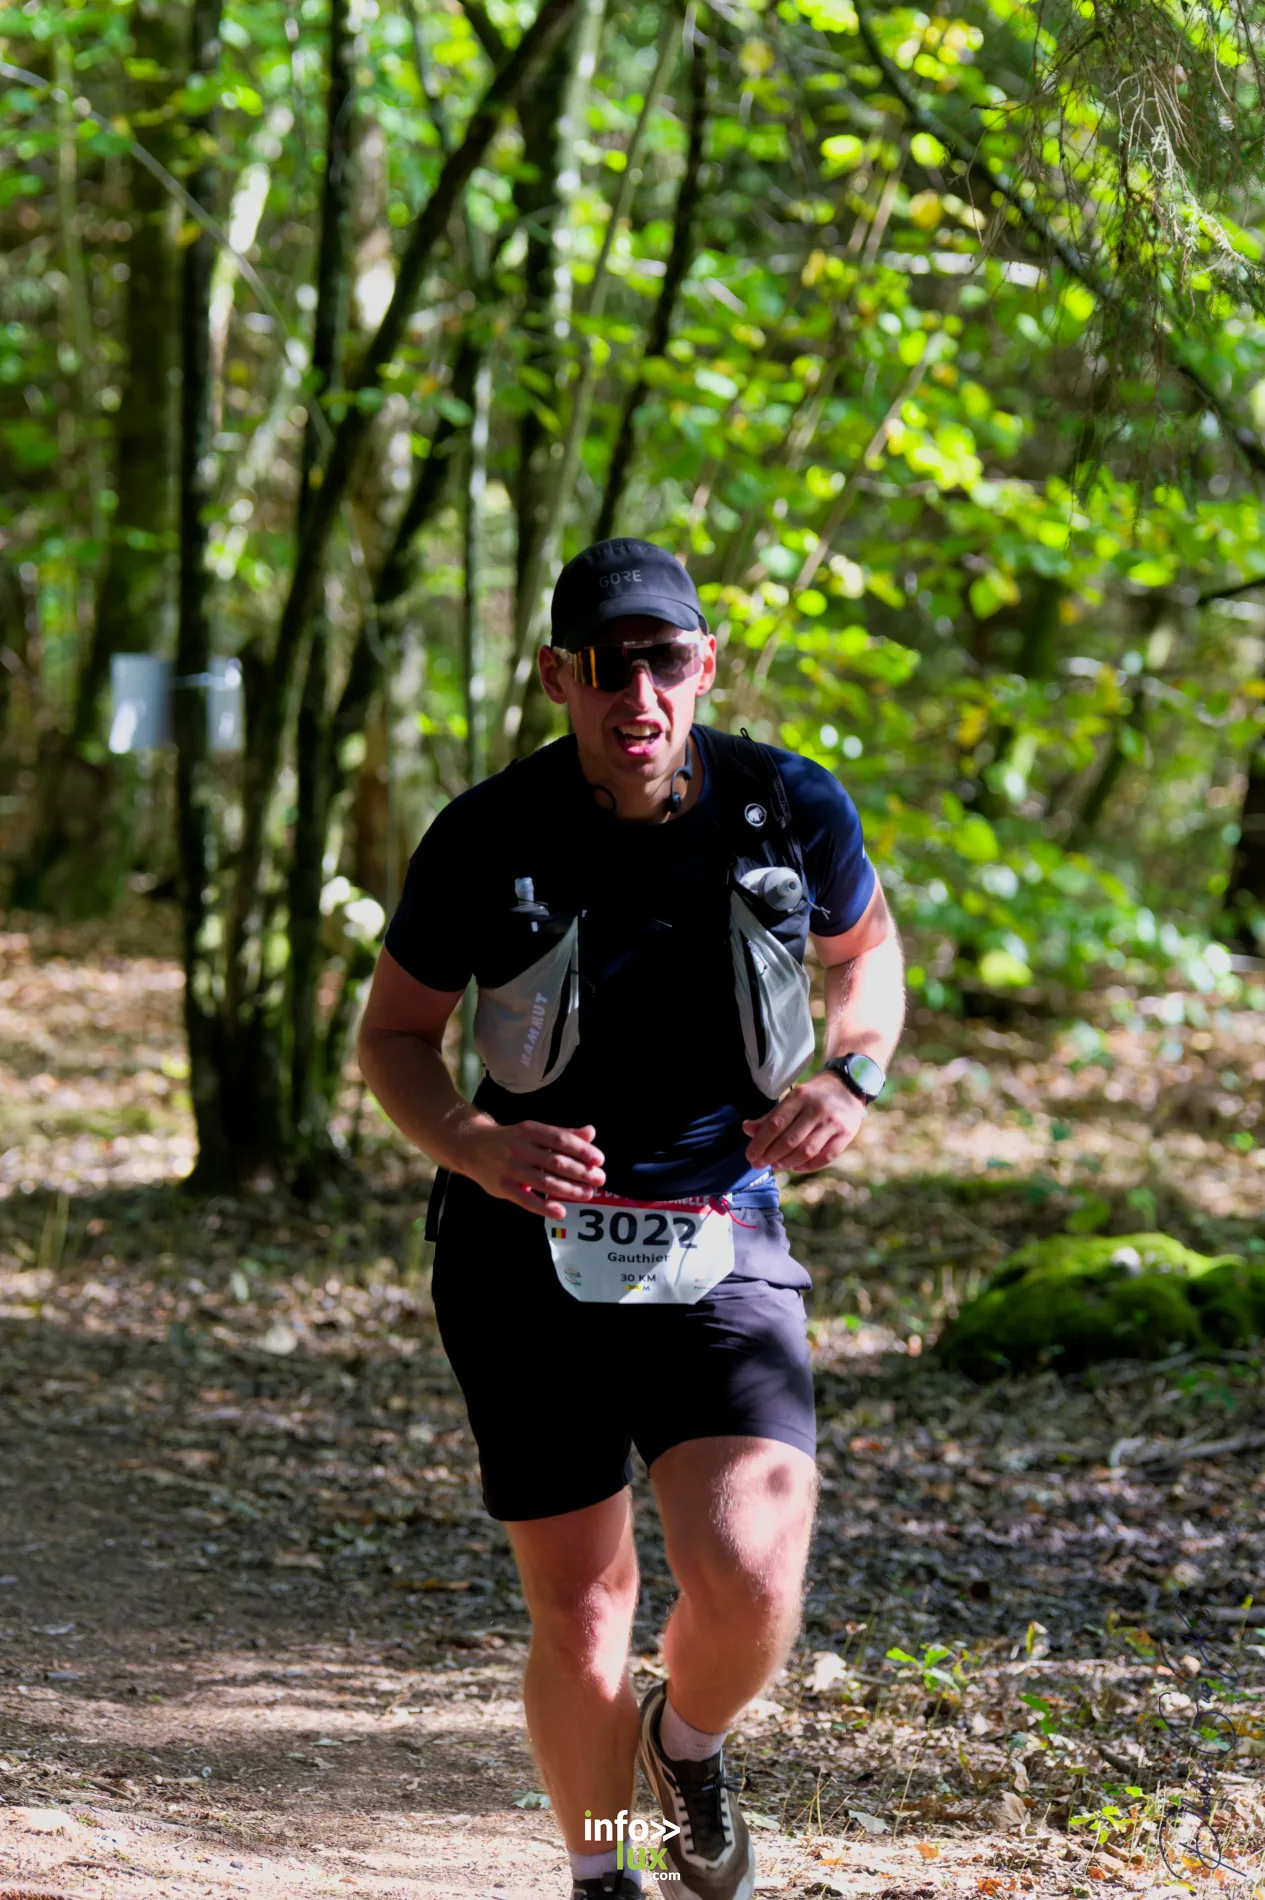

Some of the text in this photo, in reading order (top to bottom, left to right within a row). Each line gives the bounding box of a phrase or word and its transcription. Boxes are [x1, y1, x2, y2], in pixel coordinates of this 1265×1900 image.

[599, 569, 643, 588] GORE
[521, 992, 548, 1070] MAMMUT
[577, 1209, 698, 1249] 3022
[607, 1251, 671, 1264] Gauthier
[620, 1273, 656, 1282] 30 KM
